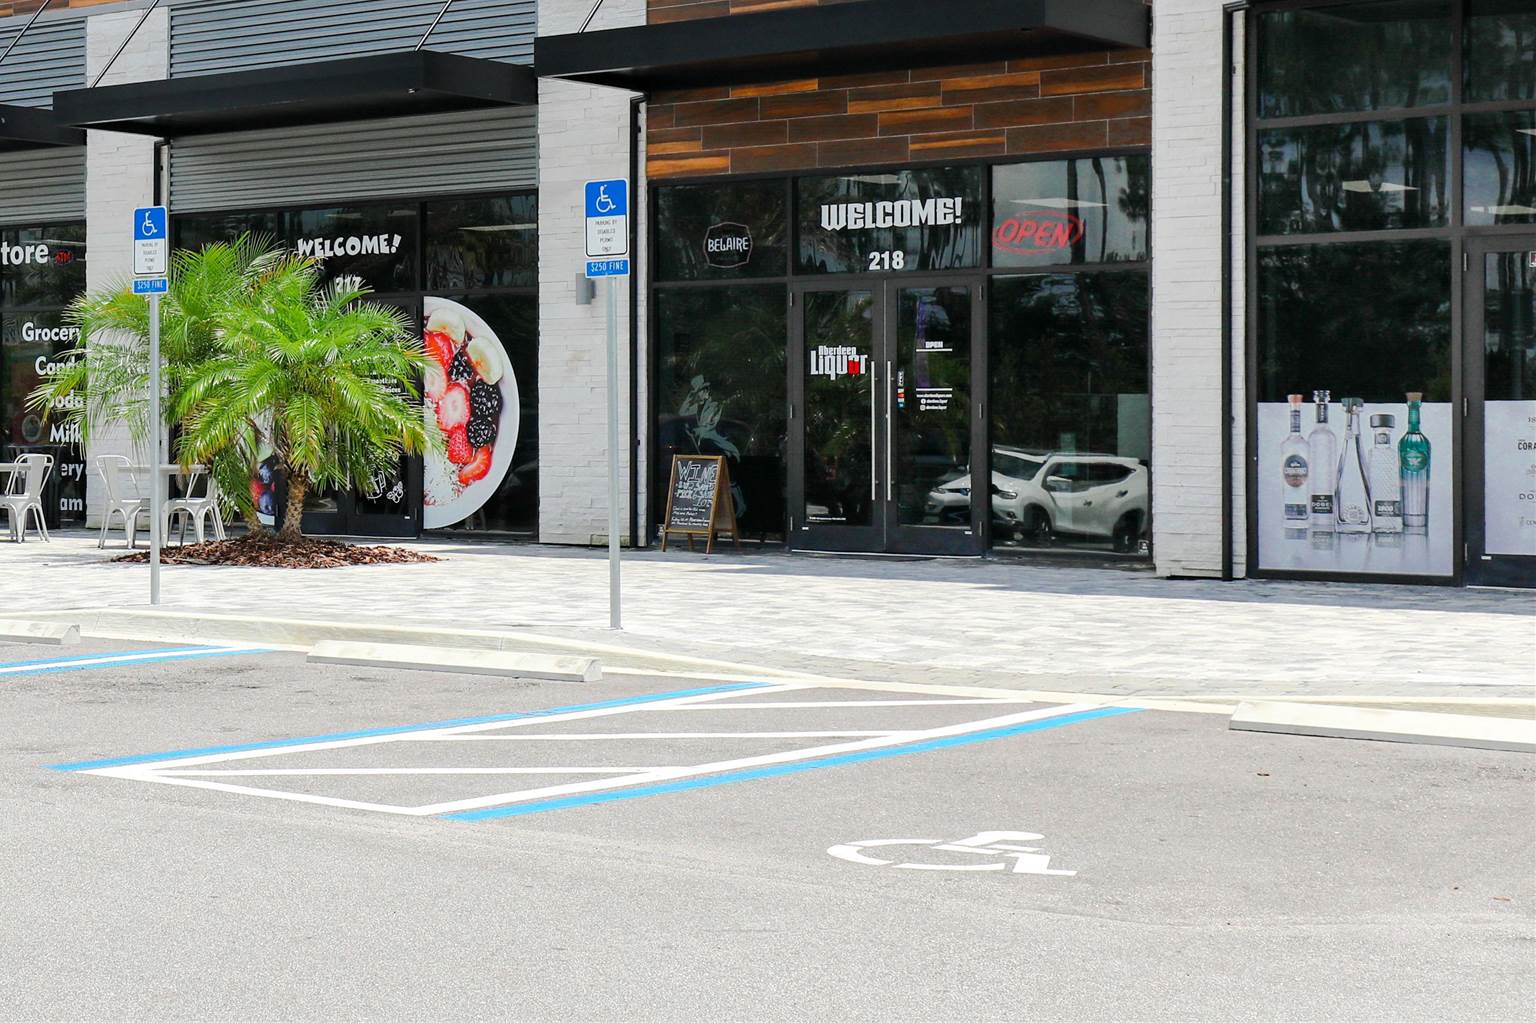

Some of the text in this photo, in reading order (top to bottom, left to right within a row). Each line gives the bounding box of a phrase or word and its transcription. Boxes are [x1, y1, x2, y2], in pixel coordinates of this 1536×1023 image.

[820, 197, 963, 232] WELCOME!
[997, 217, 1074, 247] OPEN
[297, 233, 402, 257] WELCOME!
[707, 236, 750, 253] BELAIRE
[591, 260, 624, 273] $250 FINE
[868, 250, 904, 271] 218
[818, 344, 857, 356] Aberdeen
[49, 422, 82, 443] Milk
